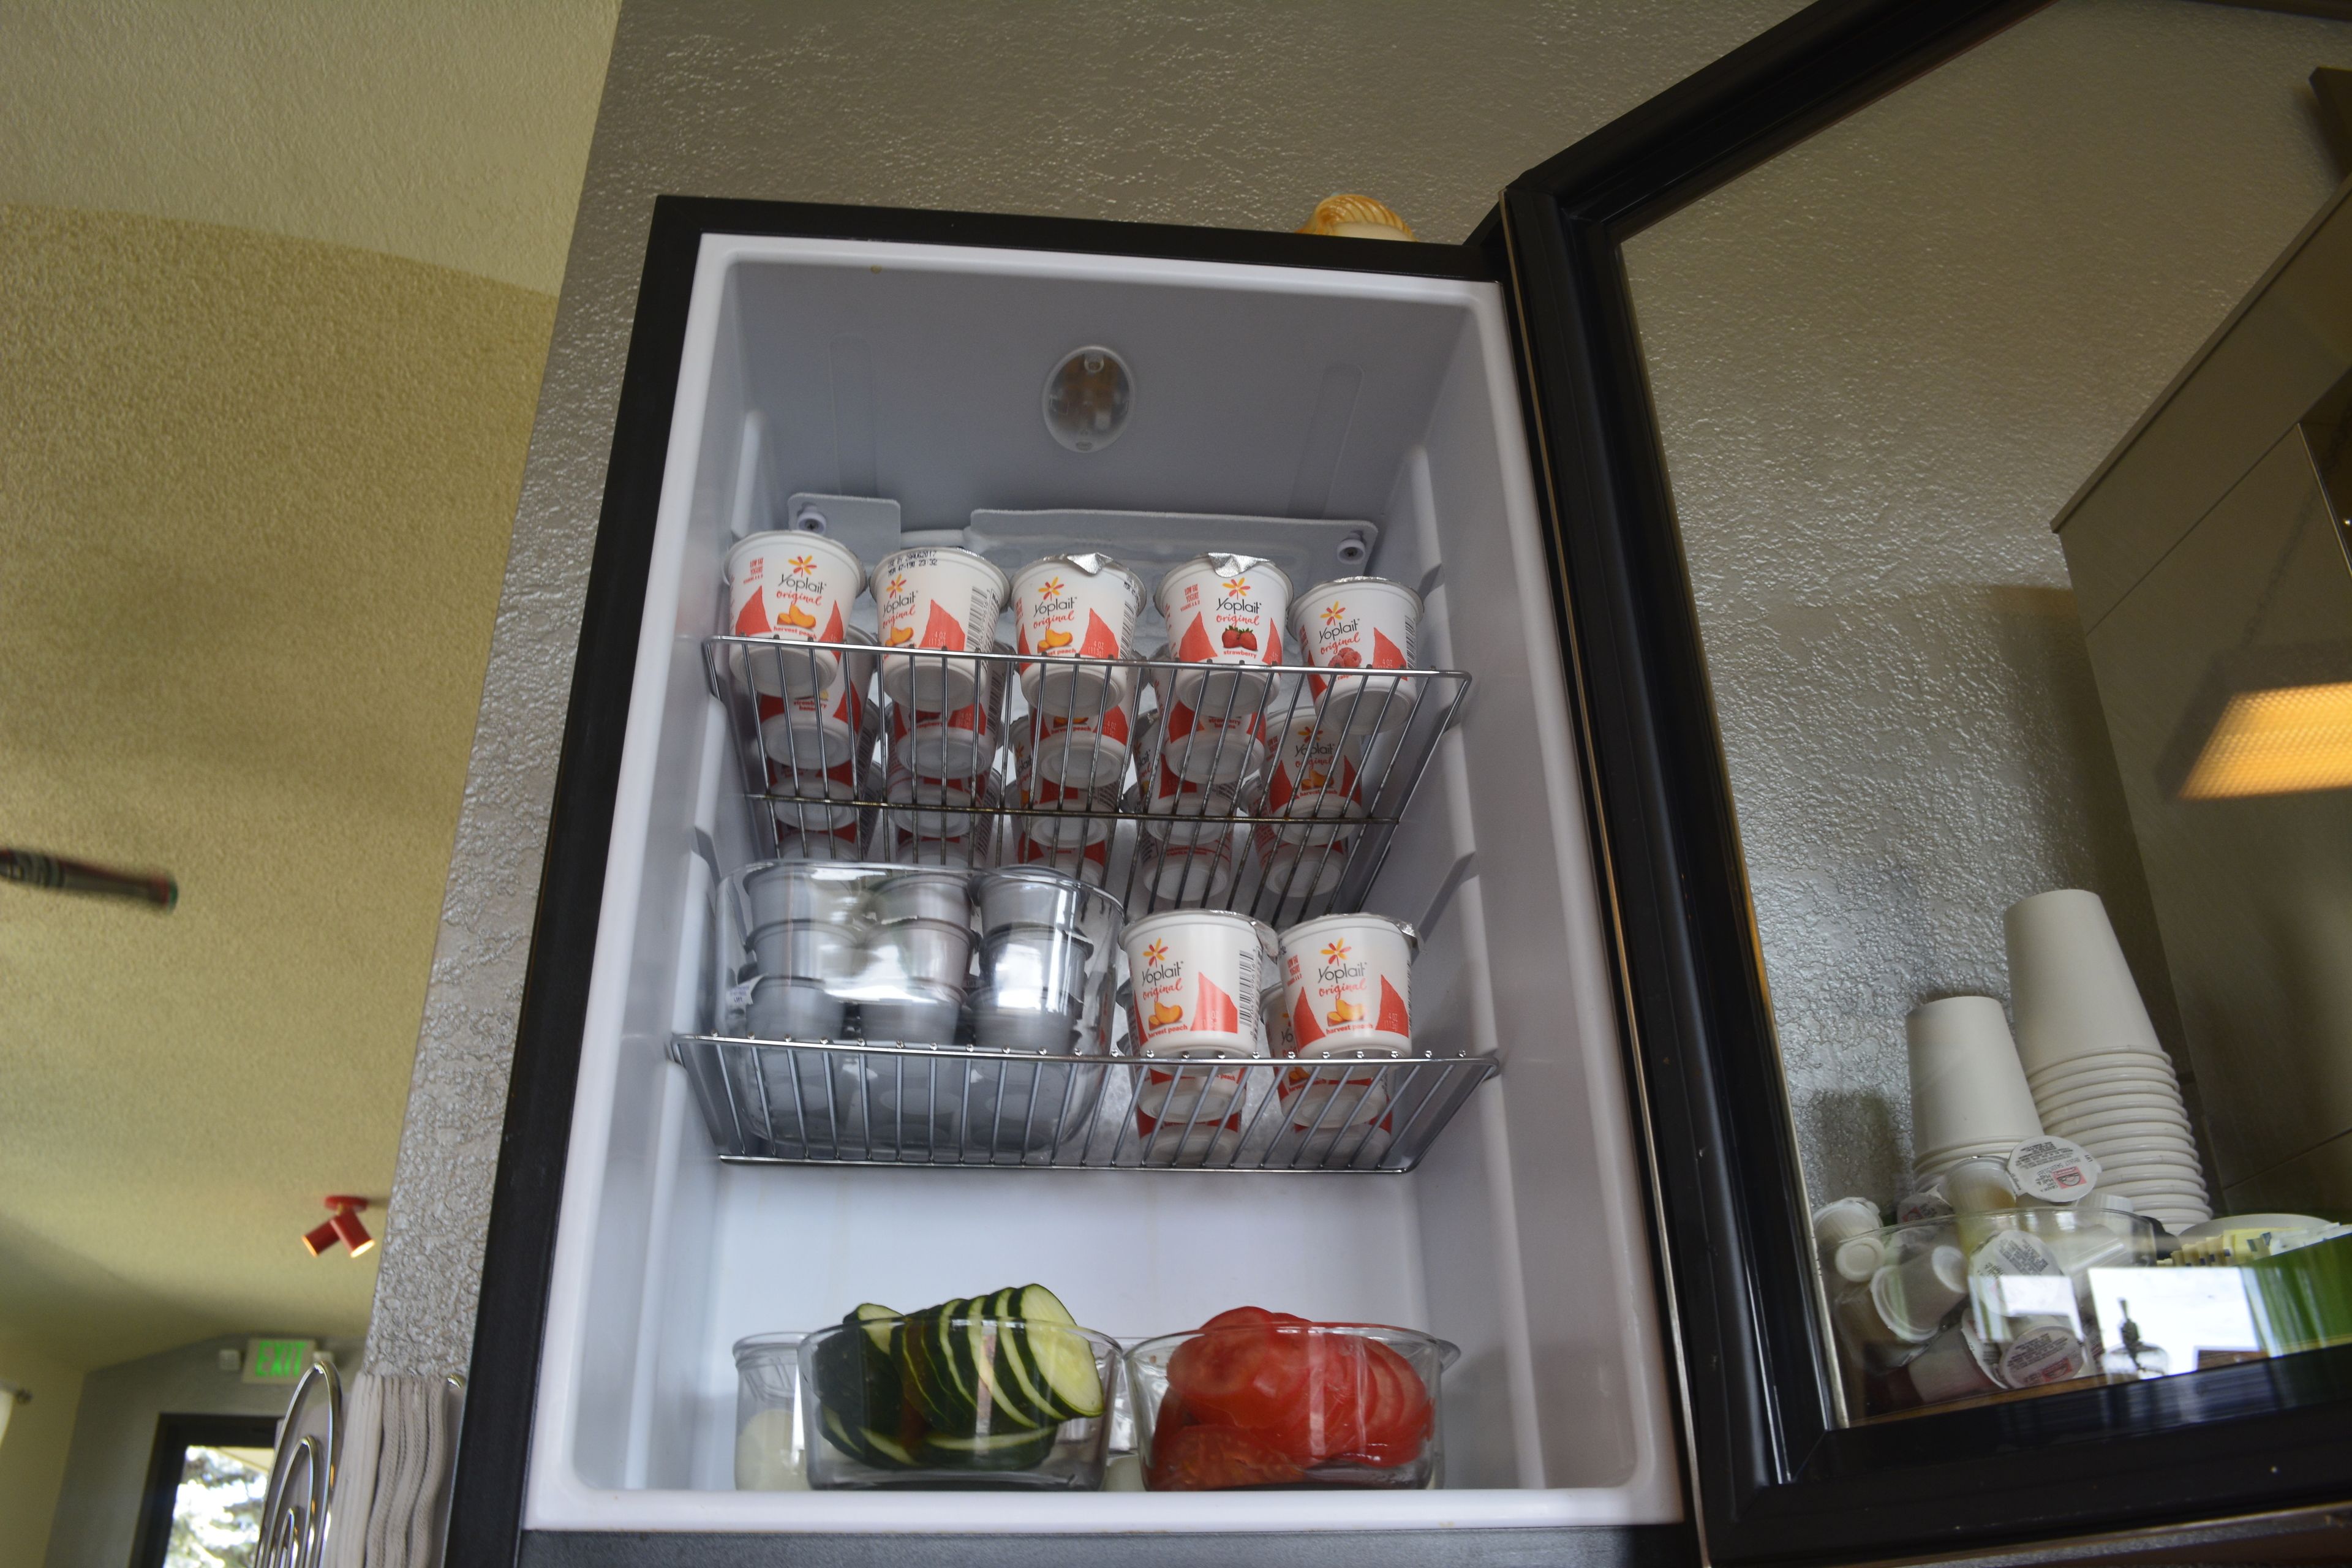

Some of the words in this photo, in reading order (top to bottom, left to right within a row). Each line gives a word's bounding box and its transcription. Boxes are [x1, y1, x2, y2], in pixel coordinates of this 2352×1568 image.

[778, 574, 824, 594] Yoplait
[776, 590, 822, 606] original
[883, 591, 916, 617] Yoplait
[1034, 597, 1074, 617] Yoplait
[1216, 598, 1260, 614] Yoplait
[883, 605, 915, 628] original
[1033, 610, 1074, 630] original
[1216, 614, 1260, 627] original
[1319, 619, 1358, 643] Yoplait
[1223, 650, 1257, 658] strawberry
[1321, 632, 1360, 655] original
[1142, 962, 1182, 987] Yoplait
[1318, 962, 1366, 984] Yoplait
[1143, 978, 1183, 1003] original
[1319, 978, 1367, 1000] original
[1148, 1028, 1167, 1039] harvest
[1168, 1024, 1188, 1033] peach
[1326, 1025, 1351, 1034] harvest
[255, 1341, 307, 1376] EXIT
